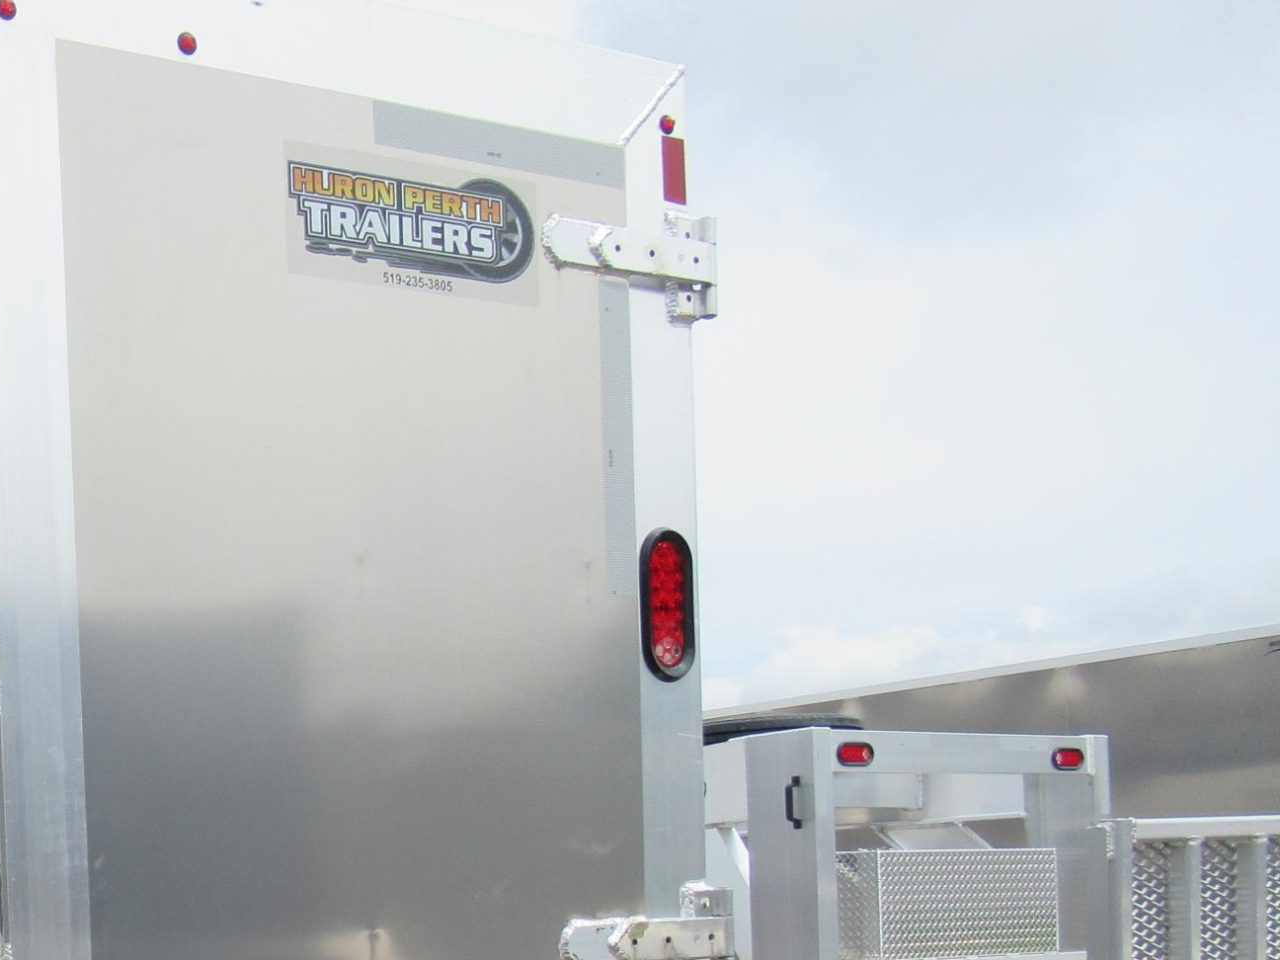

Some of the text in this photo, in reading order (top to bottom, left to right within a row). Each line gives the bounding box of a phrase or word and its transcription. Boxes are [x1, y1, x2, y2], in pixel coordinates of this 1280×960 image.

[292, 166, 501, 225] HURON PERTH
[303, 199, 494, 258] TRAILERS
[382, 271, 453, 292] 519-235-3805
